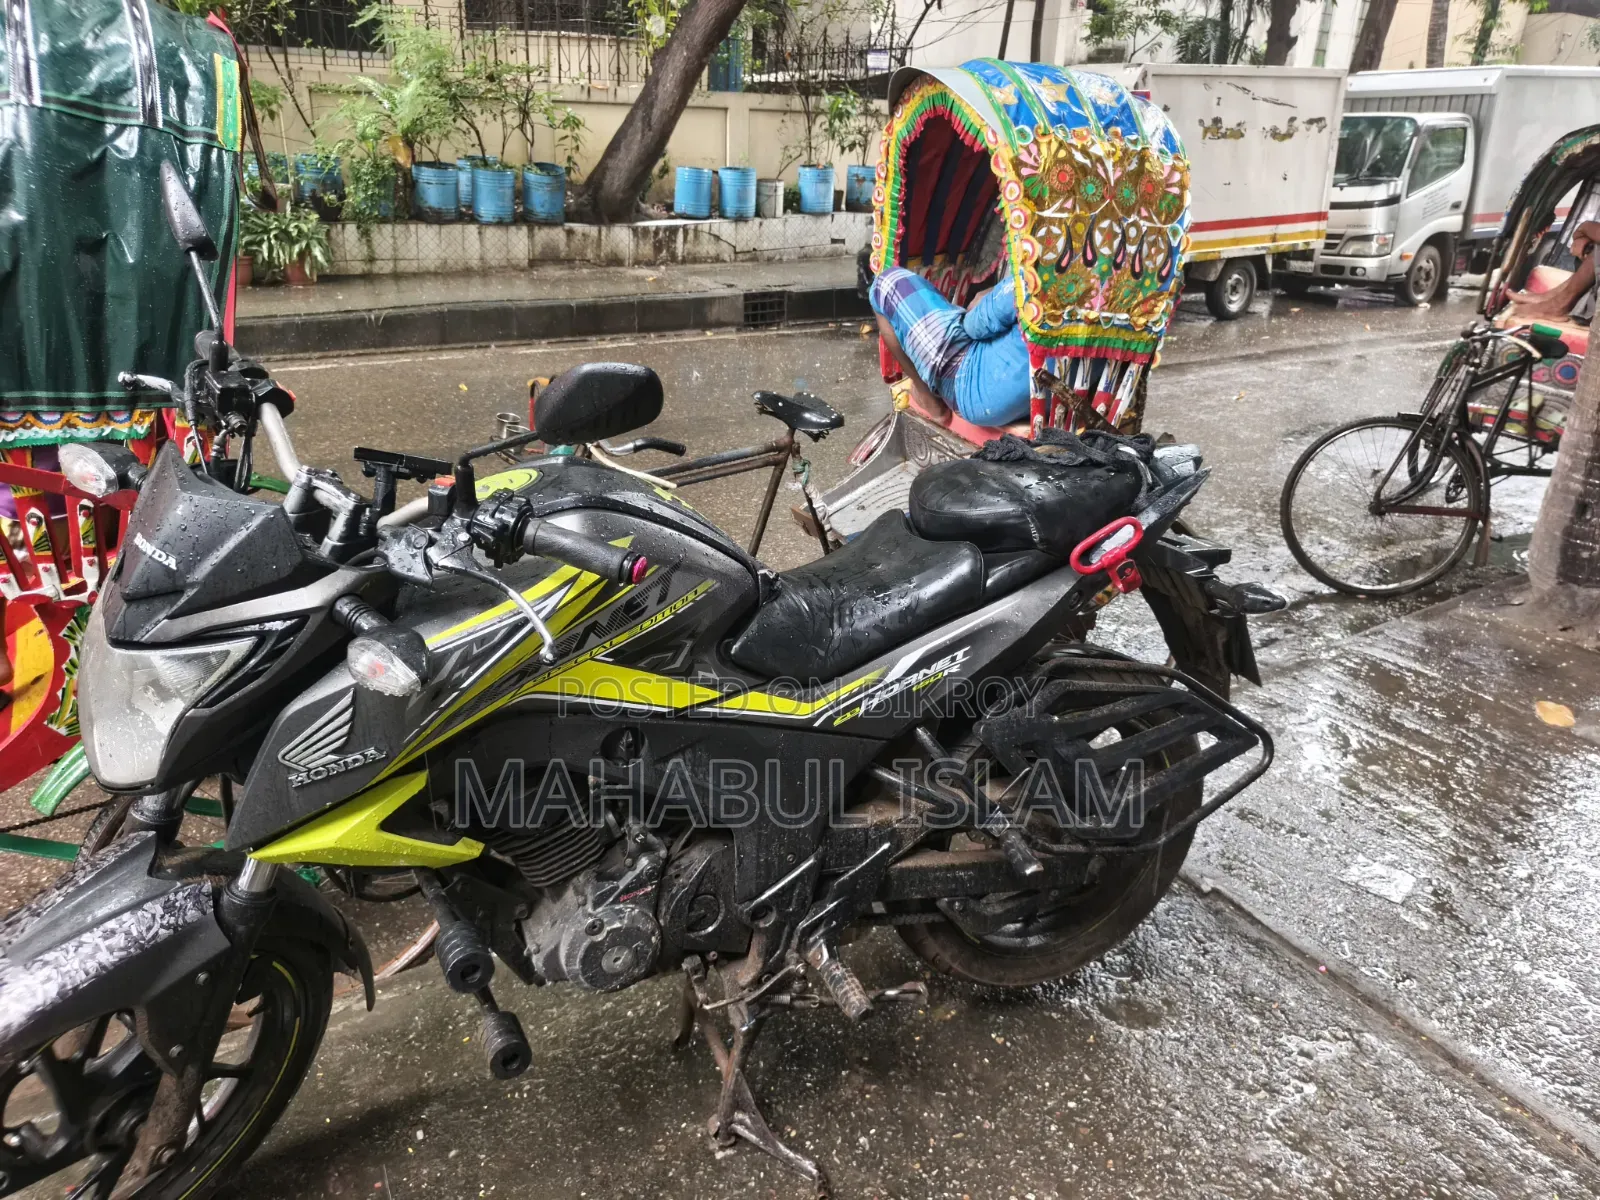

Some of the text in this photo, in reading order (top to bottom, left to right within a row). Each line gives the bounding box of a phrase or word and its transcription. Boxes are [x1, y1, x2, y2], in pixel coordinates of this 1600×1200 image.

[133, 532, 177, 570] HONDA
[858, 645, 971, 718] HORNET
[288, 747, 387, 788] HONDA
